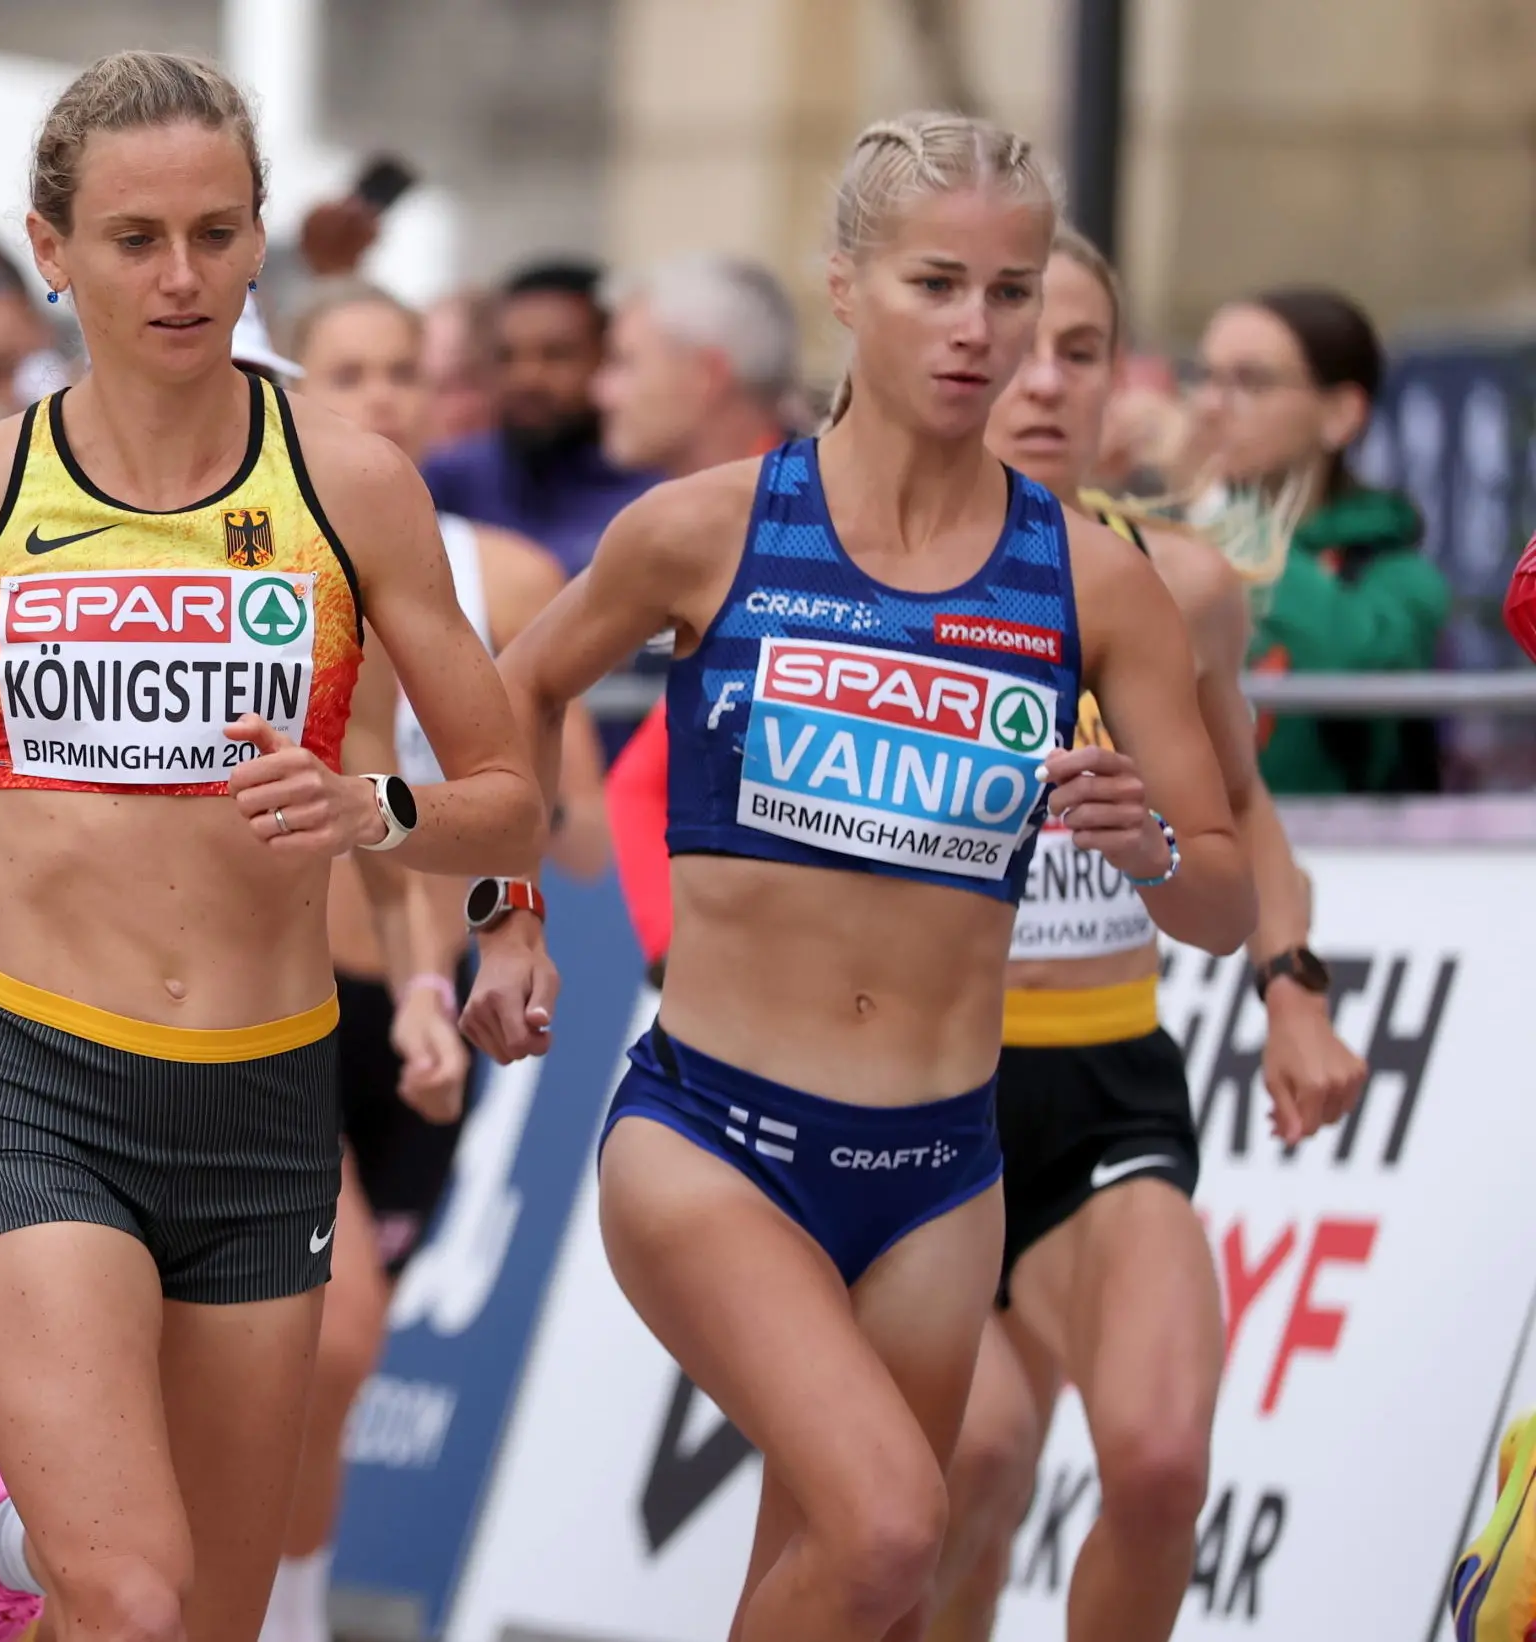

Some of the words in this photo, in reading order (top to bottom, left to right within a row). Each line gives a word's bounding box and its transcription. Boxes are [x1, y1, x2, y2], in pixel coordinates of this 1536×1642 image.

[12, 585, 225, 633] SPAR
[746, 592, 851, 623] CRAFT
[940, 621, 1057, 657] motonet
[4, 644, 302, 723] KÖNIGSTEIN
[771, 653, 980, 731] SPAR
[24, 739, 216, 770] BIRMINGHAM
[222, 742, 262, 768] 20
[764, 716, 1026, 824] VAINIO
[752, 793, 941, 858] BIRMINGHAM
[942, 838, 1003, 866] 2026
[830, 1147, 931, 1170] CRAFT
